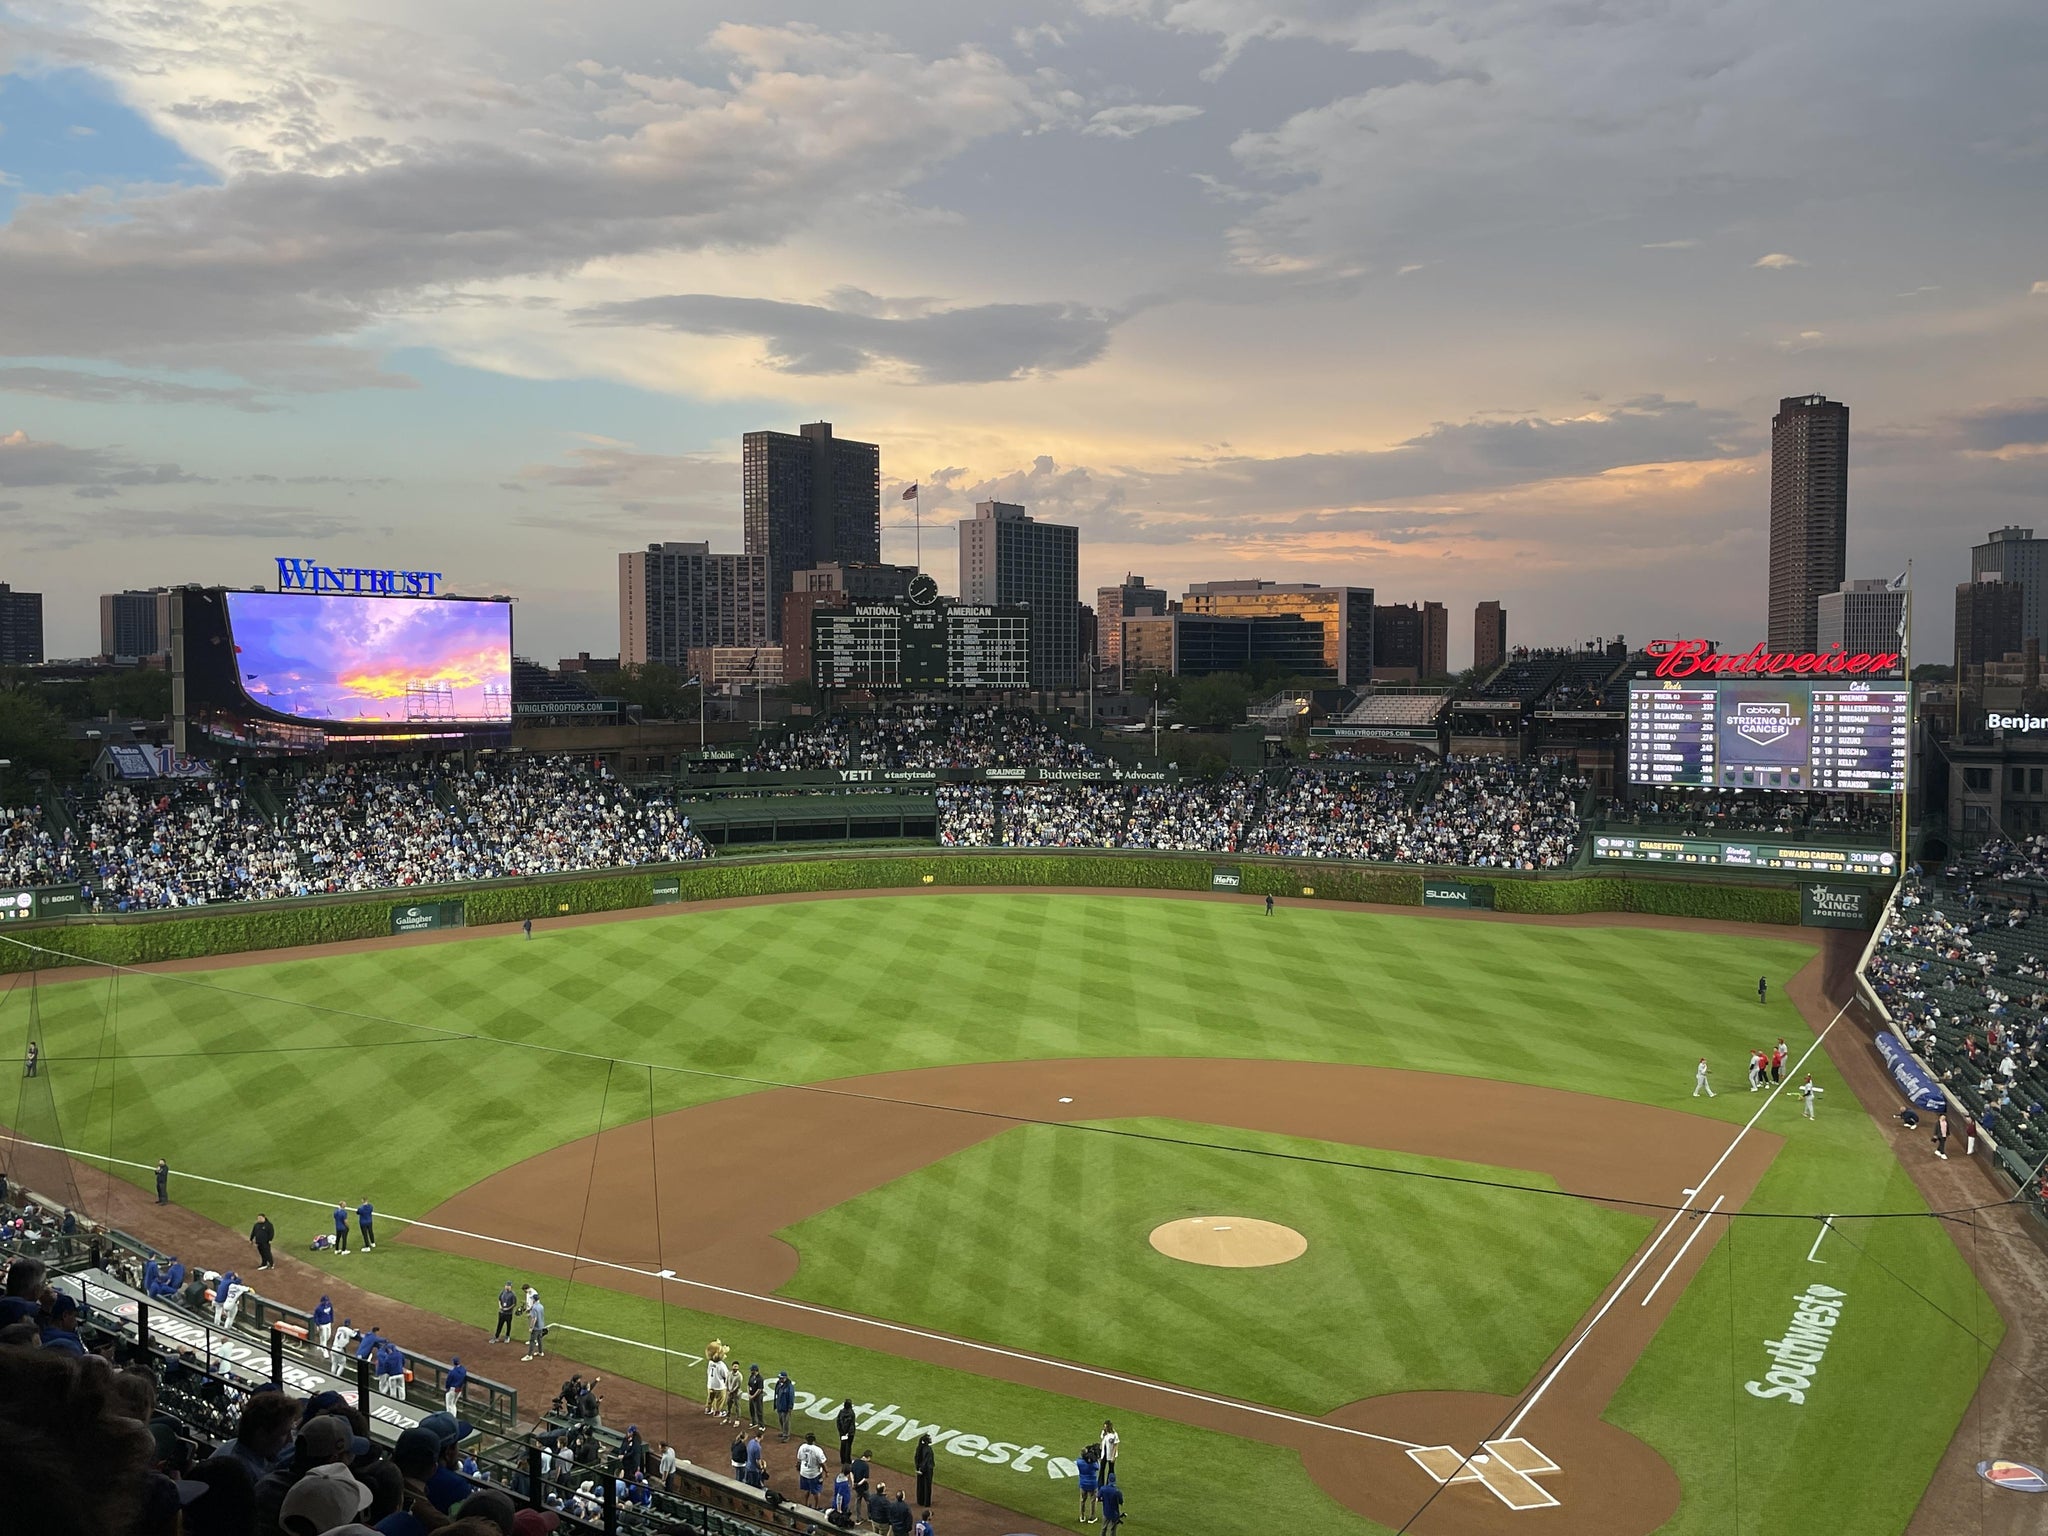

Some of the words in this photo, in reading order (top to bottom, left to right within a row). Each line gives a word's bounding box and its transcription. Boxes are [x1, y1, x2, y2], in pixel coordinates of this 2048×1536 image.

[275, 557, 442, 595] WINTRUST
[855, 606, 901, 616] NATIONAL
[947, 607, 992, 616] AMERICAN
[1647, 639, 1898, 678] Budweiser
[1663, 681, 1682, 690] Reds
[1849, 681, 1870, 691] Cubs
[517, 703, 603, 713] WRIGLEYROOFTOPS.COM
[1726, 716, 1777, 725] STRIKING
[1779, 717, 1801, 725] OUT
[1742, 725, 1785, 733] CANCER
[1812, 736, 1820, 744] 27
[711, 751, 734, 759] Mobile
[840, 770, 872, 781] YETI
[891, 771, 936, 782] tastytrade
[1039, 769, 1100, 780] Budweiser
[1125, 770, 1164, 780] Advocate
[1837, 780, 1869, 788] SWANSON
[1640, 842, 1663, 850] CHASE
[1663, 843, 1684, 851] PETTY
[1779, 850, 1810, 858] EDWARD
[1811, 851, 1846, 861] CABRERA
[1850, 853, 1860, 861] 30
[1863, 854, 1879, 862] RHP
[1215, 876, 1238, 885] Hefty
[52, 895, 74, 903] BOSCH
[1426, 890, 1466, 899] SLOAN
[1813, 890, 1861, 903] DRAFT
[1818, 902, 1859, 911] KINGS
[1813, 910, 1863, 919] SPORTSBOOK
[396, 915, 432, 925] Gallagher
[148, 1315, 252, 1367] CHICAO
[1744, 1294, 1844, 1405] Southwest
